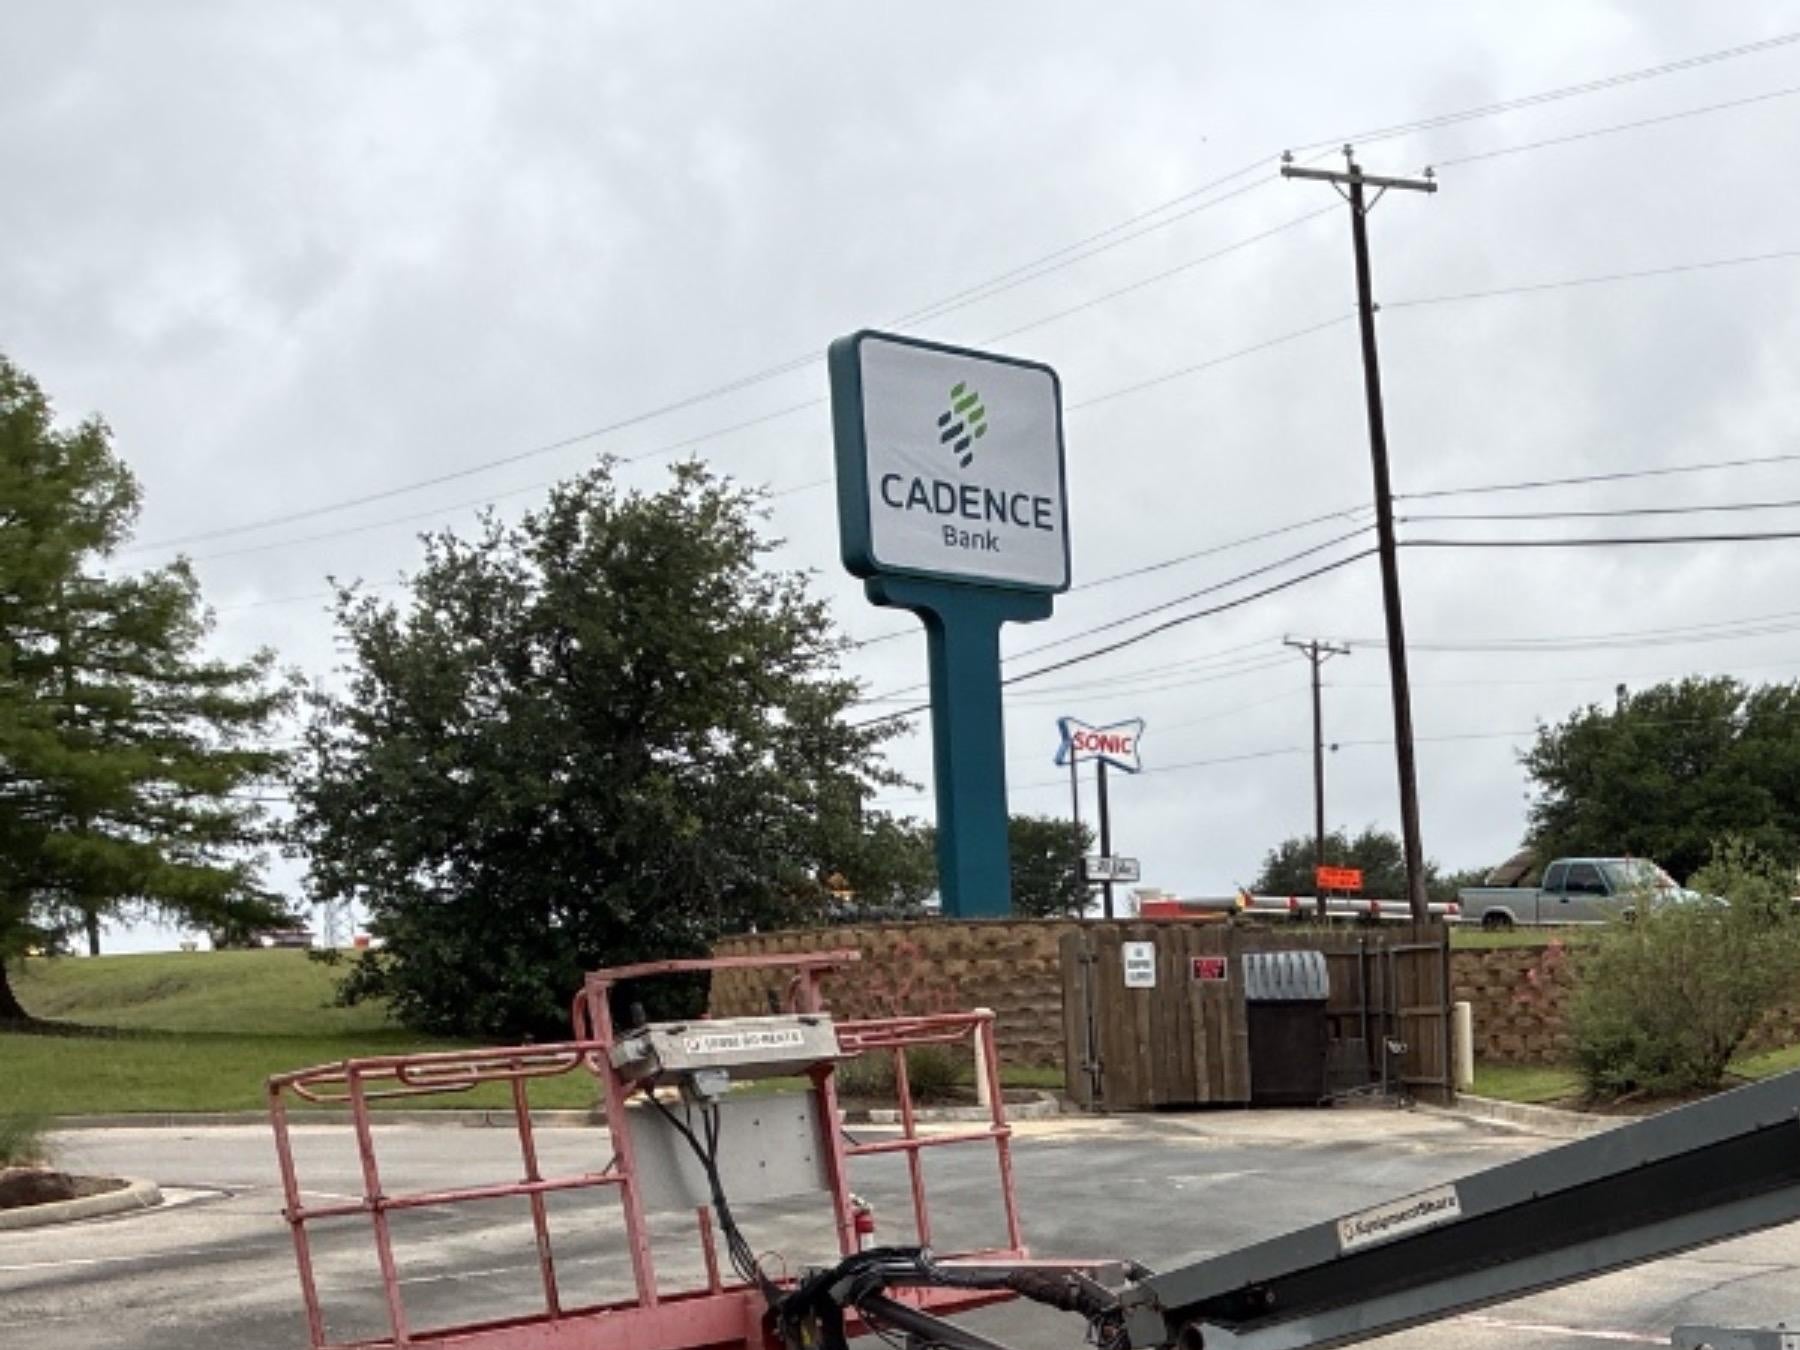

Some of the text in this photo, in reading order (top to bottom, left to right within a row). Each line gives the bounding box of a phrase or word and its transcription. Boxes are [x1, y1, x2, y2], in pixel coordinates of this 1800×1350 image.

[880, 473, 1054, 531] CADENCE
[942, 525, 1000, 553] Bank
[1072, 730, 1133, 753] SONIC
